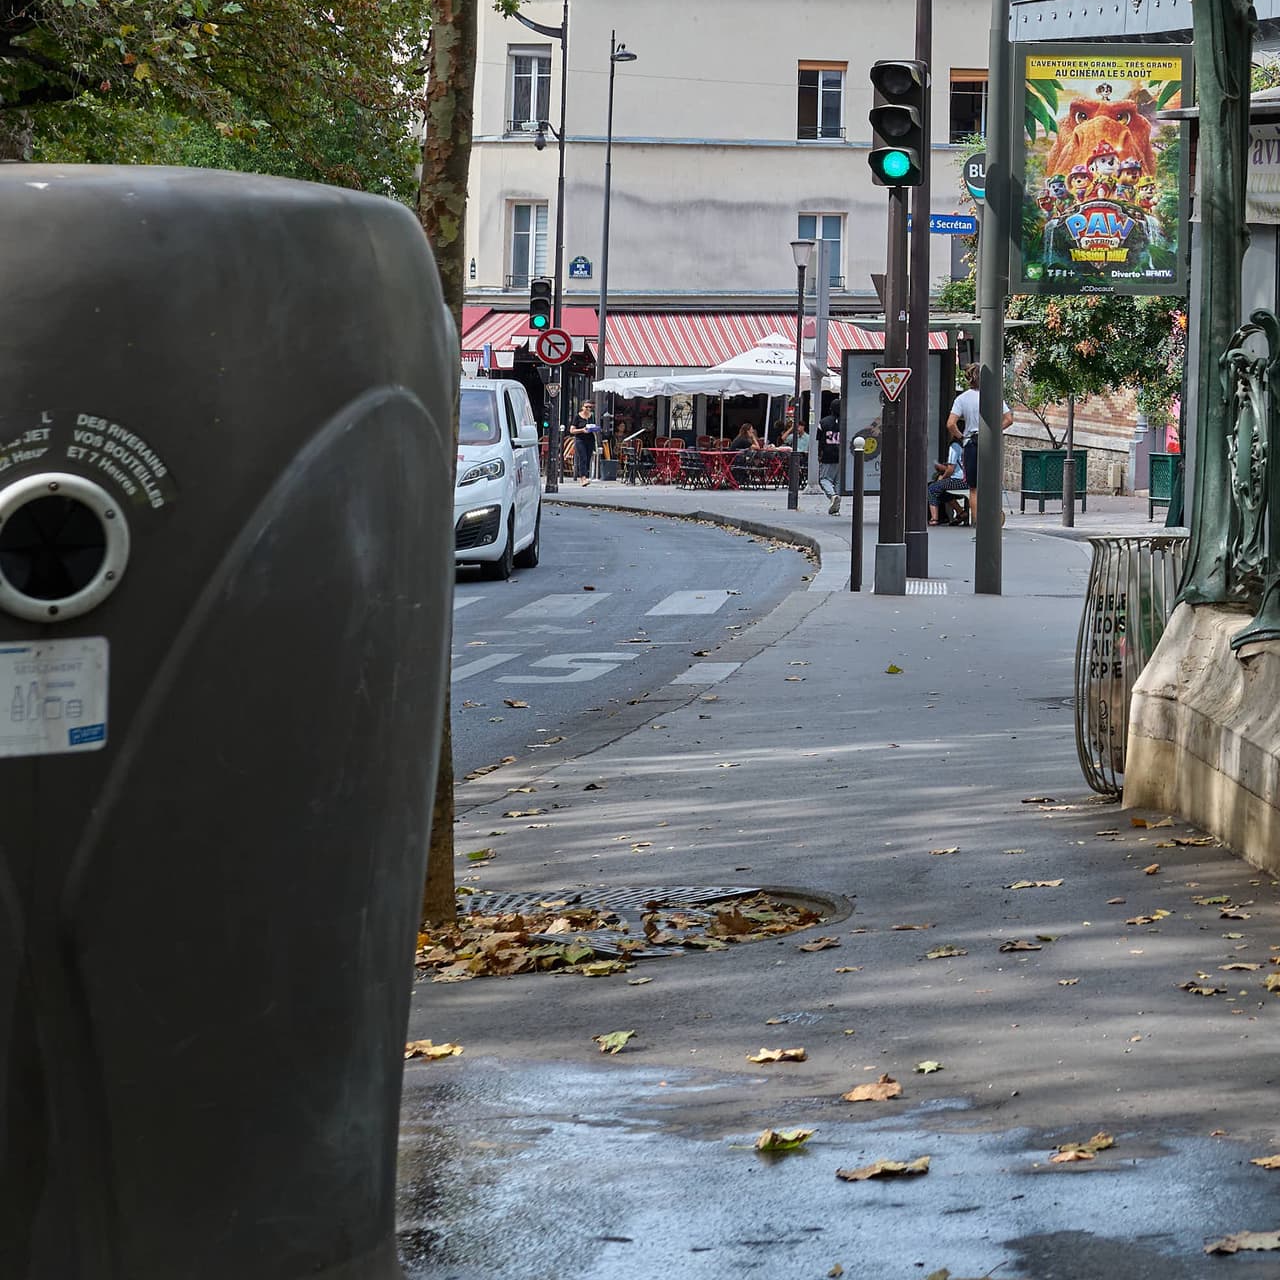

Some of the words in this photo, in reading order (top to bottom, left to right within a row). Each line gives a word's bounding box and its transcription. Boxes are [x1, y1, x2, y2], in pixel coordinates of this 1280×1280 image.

[1055, 69, 1067, 78] AU
[1069, 67, 1105, 78] CINÉMA
[1107, 69, 1118, 78] LE
[1119, 69, 1126, 78] 5
[936, 219, 972, 230] Secrétan
[1065, 212, 1137, 241] PAW
[1111, 270, 1140, 279] Diverto
[1079, 285, 1116, 293] JCDecaux
[77, 413, 107, 432] DES
[107, 423, 168, 478] RIVERAINS
[66, 445, 88, 460] ET
[88, 452, 99, 464] 7
[98, 456, 138, 496] Heures
[74, 429, 104, 448] VOS
[104, 440, 165, 509] BOUTEILLES
